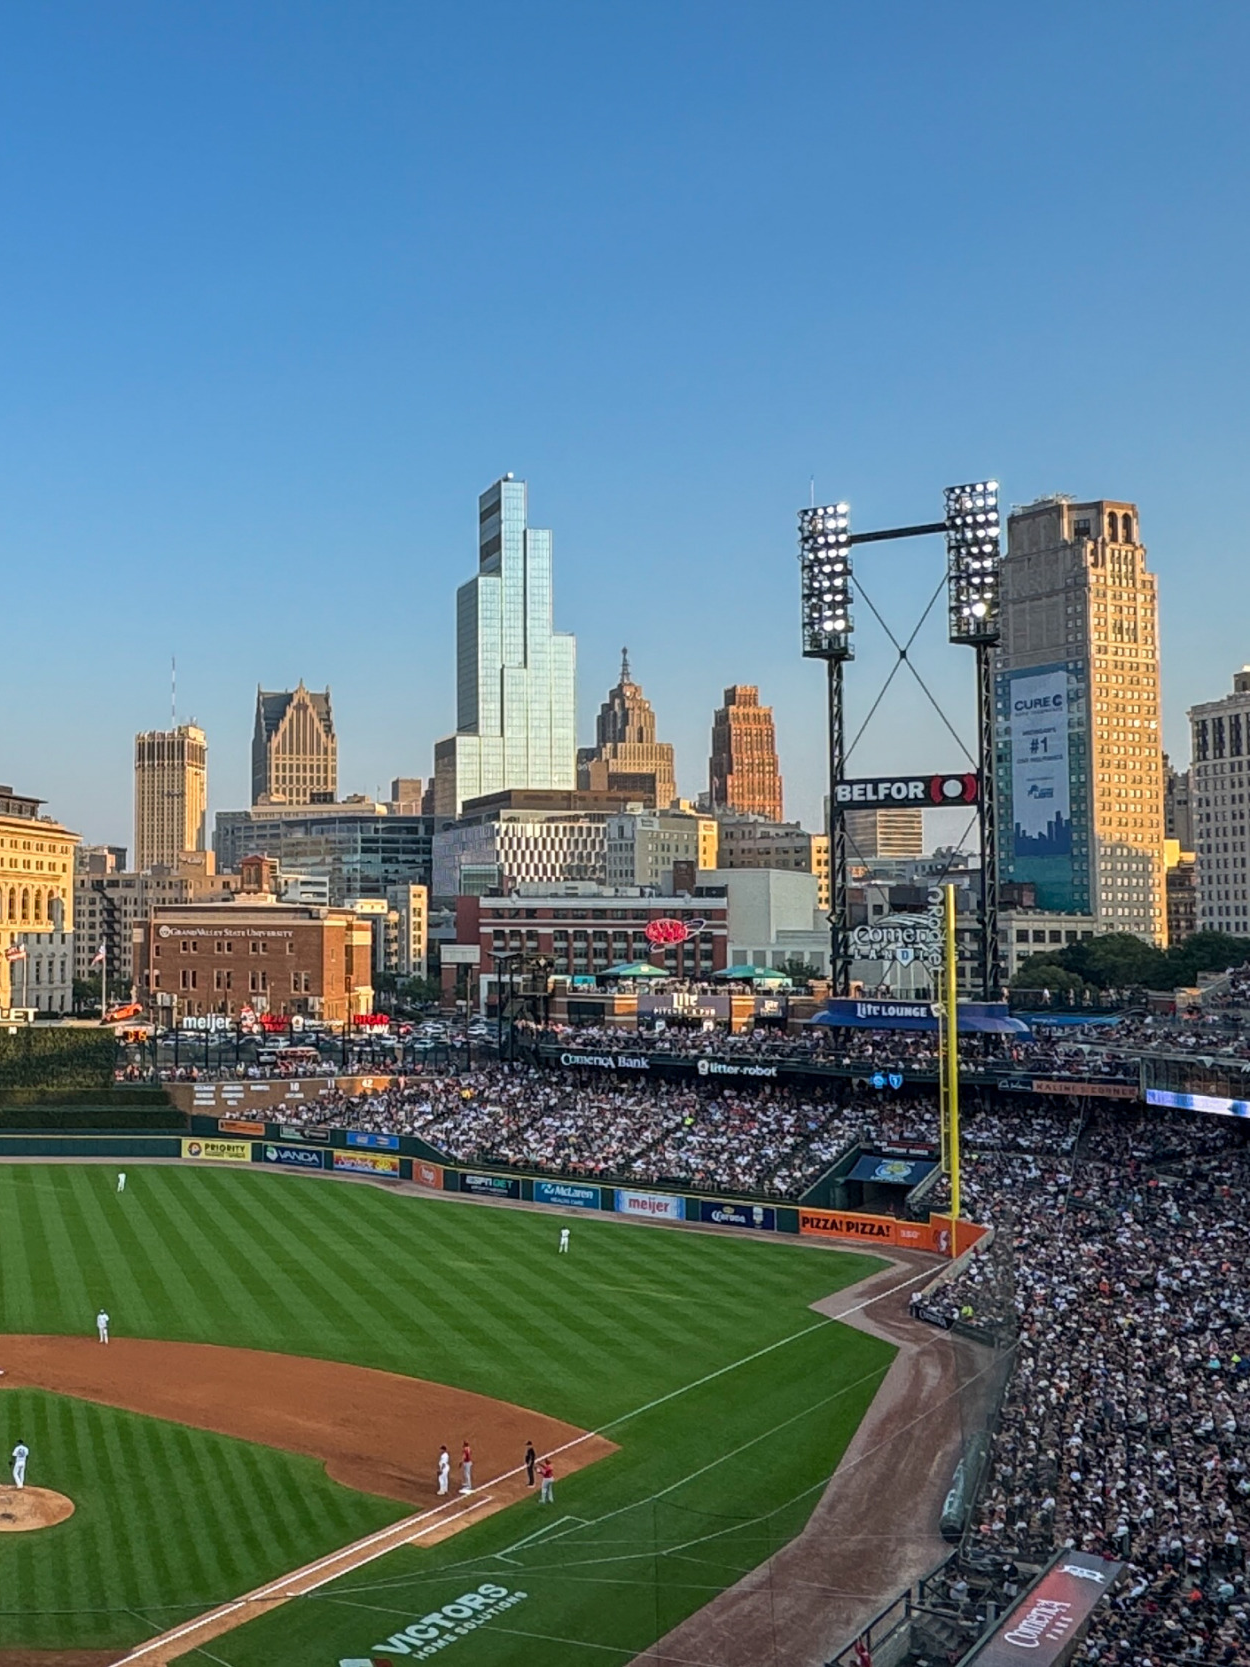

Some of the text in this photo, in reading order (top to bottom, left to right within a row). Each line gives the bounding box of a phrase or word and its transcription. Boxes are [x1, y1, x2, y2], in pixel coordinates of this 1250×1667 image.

[1014, 696, 1051, 711] CURE
[1029, 736, 1048, 753] #1
[835, 781, 925, 802] BELFOR
[856, 1003, 928, 1017] Lite LOUNGE
[183, 1013, 231, 1032] meijer
[366, 1024, 390, 1033] LAW
[618, 1055, 650, 1069] Bank
[709, 1060, 778, 1077] litter-robot
[362, 1079, 374, 1088] 42
[205, 1143, 246, 1153] PRIORITY
[279, 1150, 319, 1163] VANDA
[493, 1178, 513, 1189] BET
[554, 1186, 593, 1199] McLaren
[627, 1197, 670, 1214] meijer
[711, 1210, 746, 1224] Corona
[802, 1216, 891, 1238] PIZZA! PIZZA!
[371, 1583, 509, 1656] VICTORS
[412, 1591, 528, 1660] HOME SOLUTIONS
[1046, 1617, 1074, 1641] PARK
